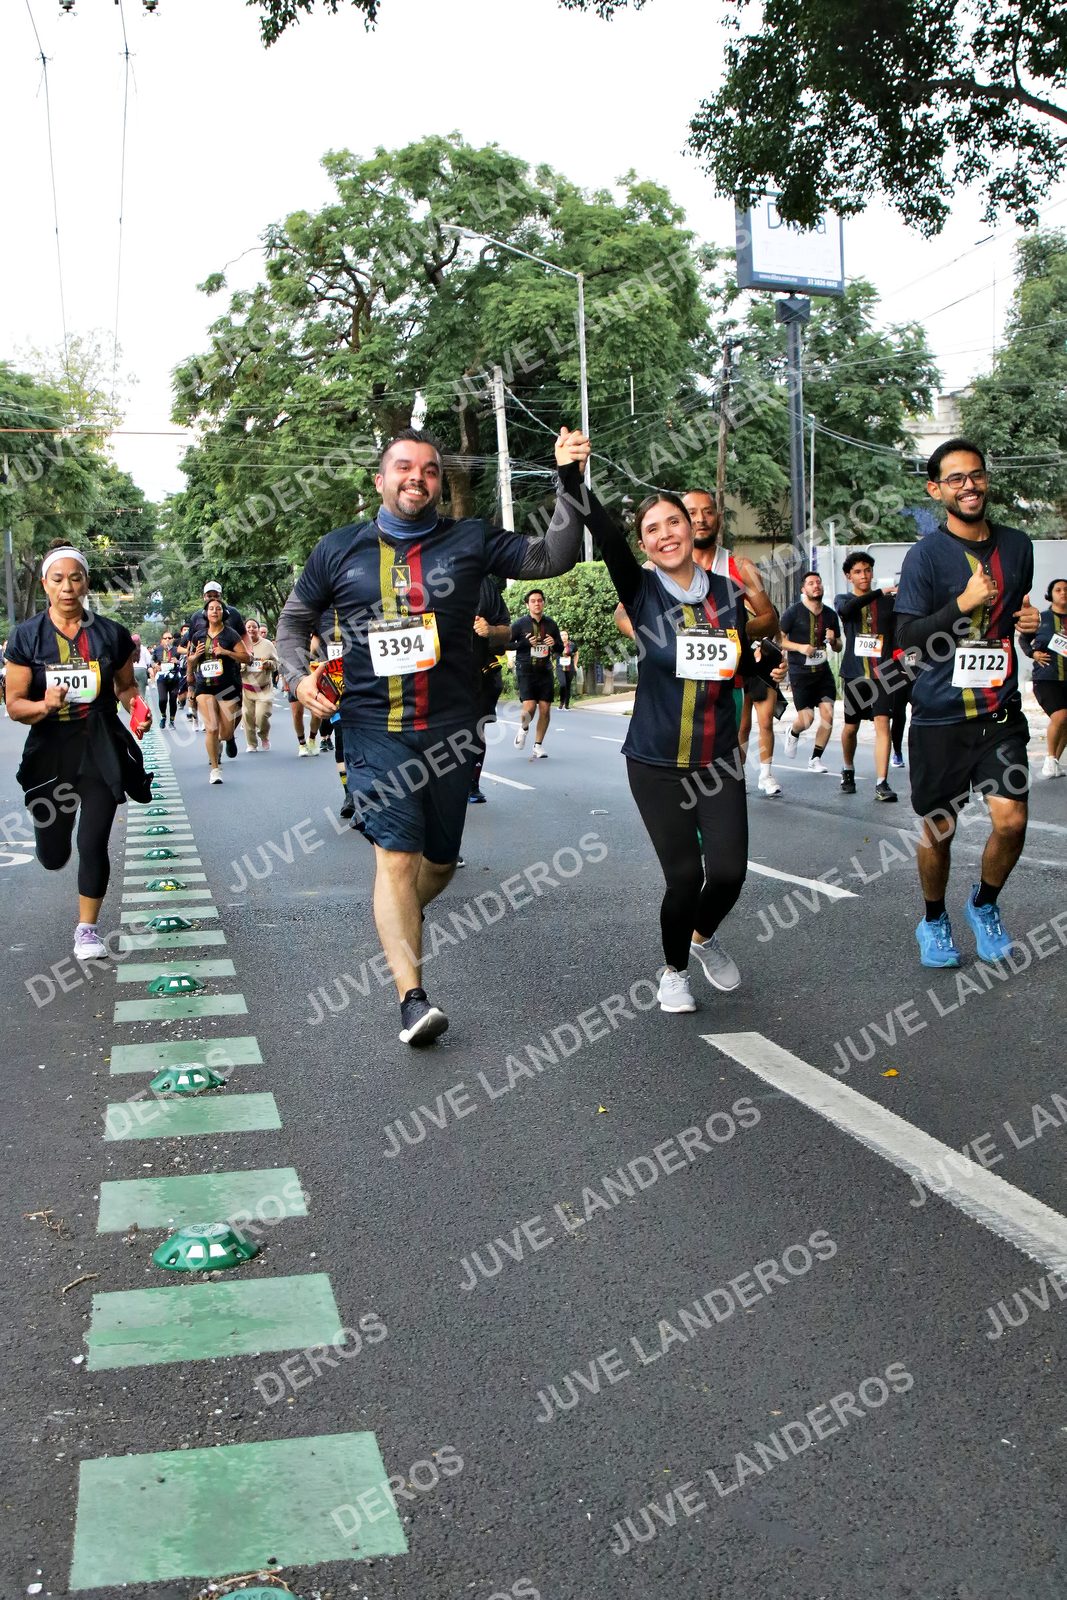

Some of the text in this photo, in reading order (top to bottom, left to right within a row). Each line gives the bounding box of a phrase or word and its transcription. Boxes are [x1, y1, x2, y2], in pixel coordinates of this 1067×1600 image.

[378, 634, 425, 657] 3394
[685, 643, 728, 661] 3395
[959, 654, 1005, 671] 12122
[54, 675, 88, 689] 2501
